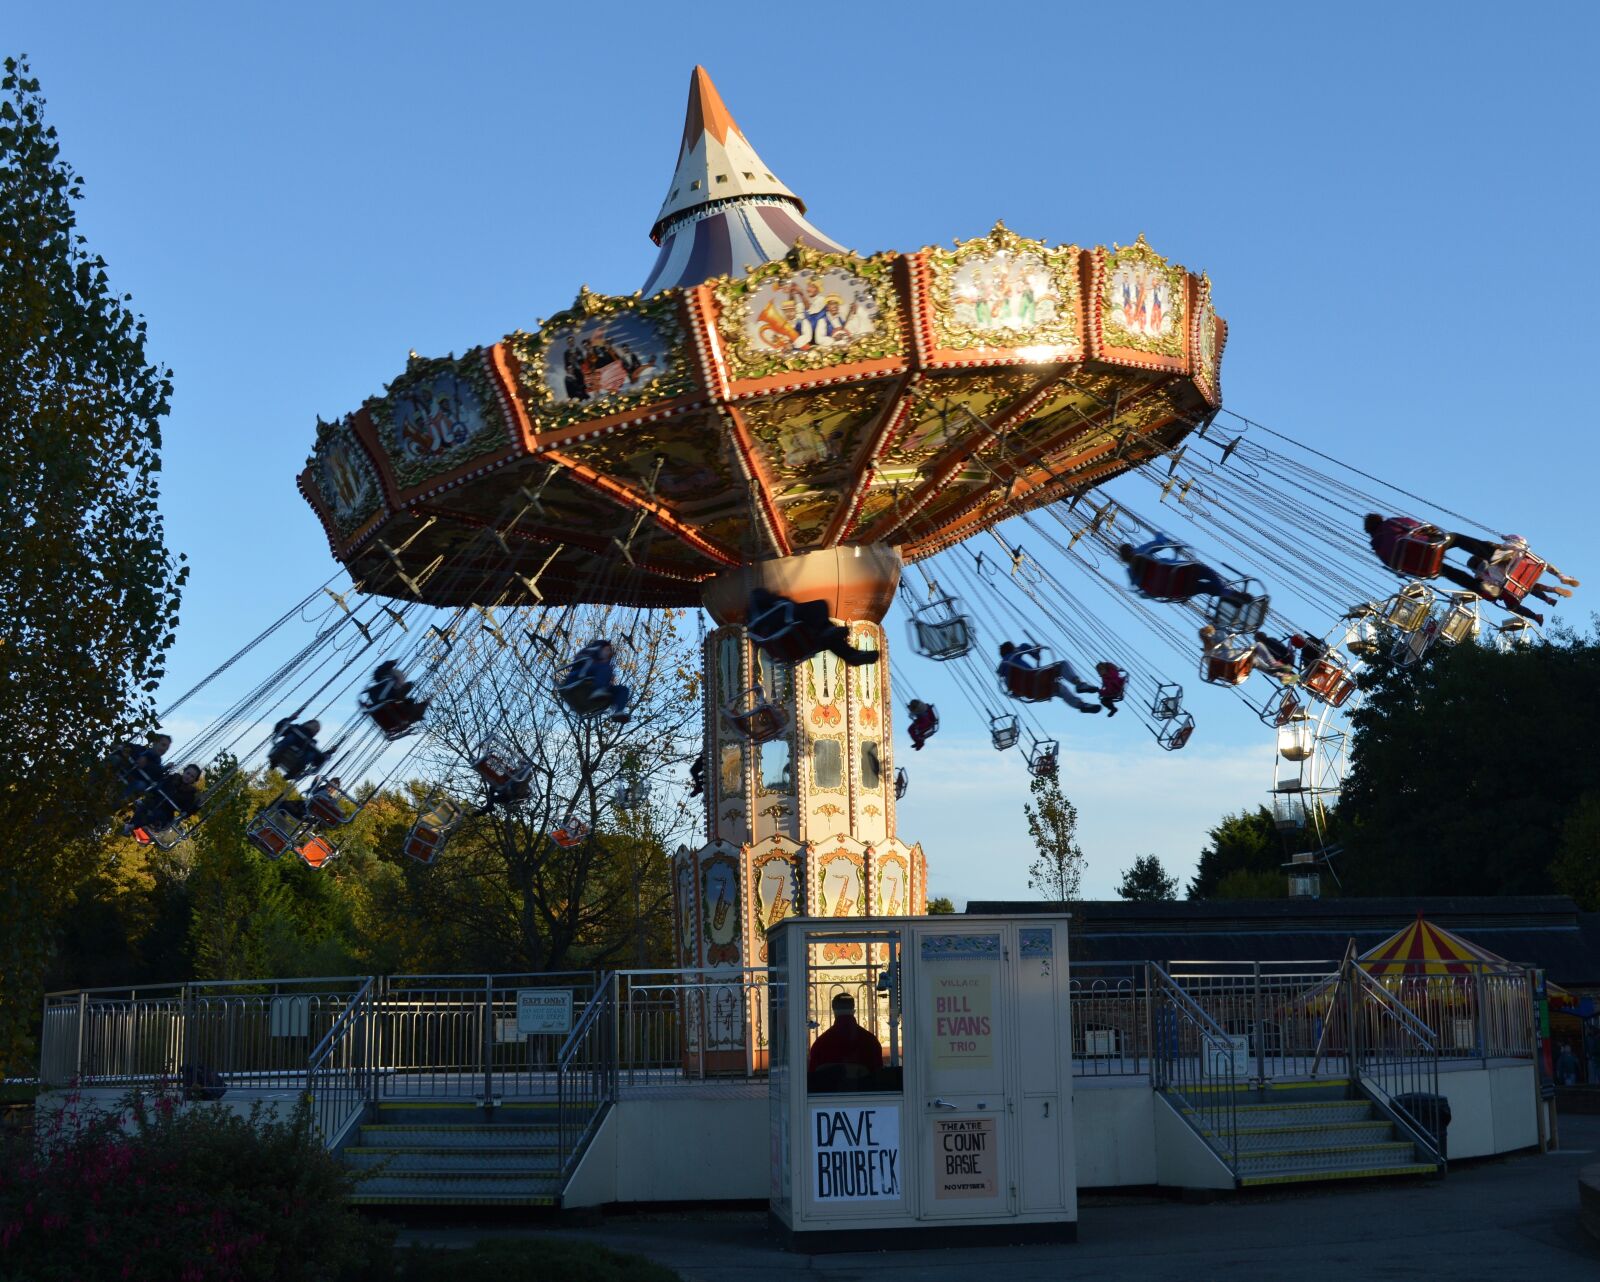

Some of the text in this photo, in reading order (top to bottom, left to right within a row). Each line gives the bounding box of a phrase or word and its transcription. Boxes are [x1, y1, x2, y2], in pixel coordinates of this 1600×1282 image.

[936, 996, 971, 1013] BILL
[936, 1016, 991, 1037] EVANS
[949, 1041, 977, 1052] TRIO
[816, 1110, 879, 1147] DAVE
[941, 1122, 983, 1131] THEATRE
[943, 1133, 986, 1152] COUNT
[817, 1149, 900, 1198] BRUBECK
[945, 1154, 982, 1175] BASIE
[944, 1183, 985, 1191] NOVEMBER
